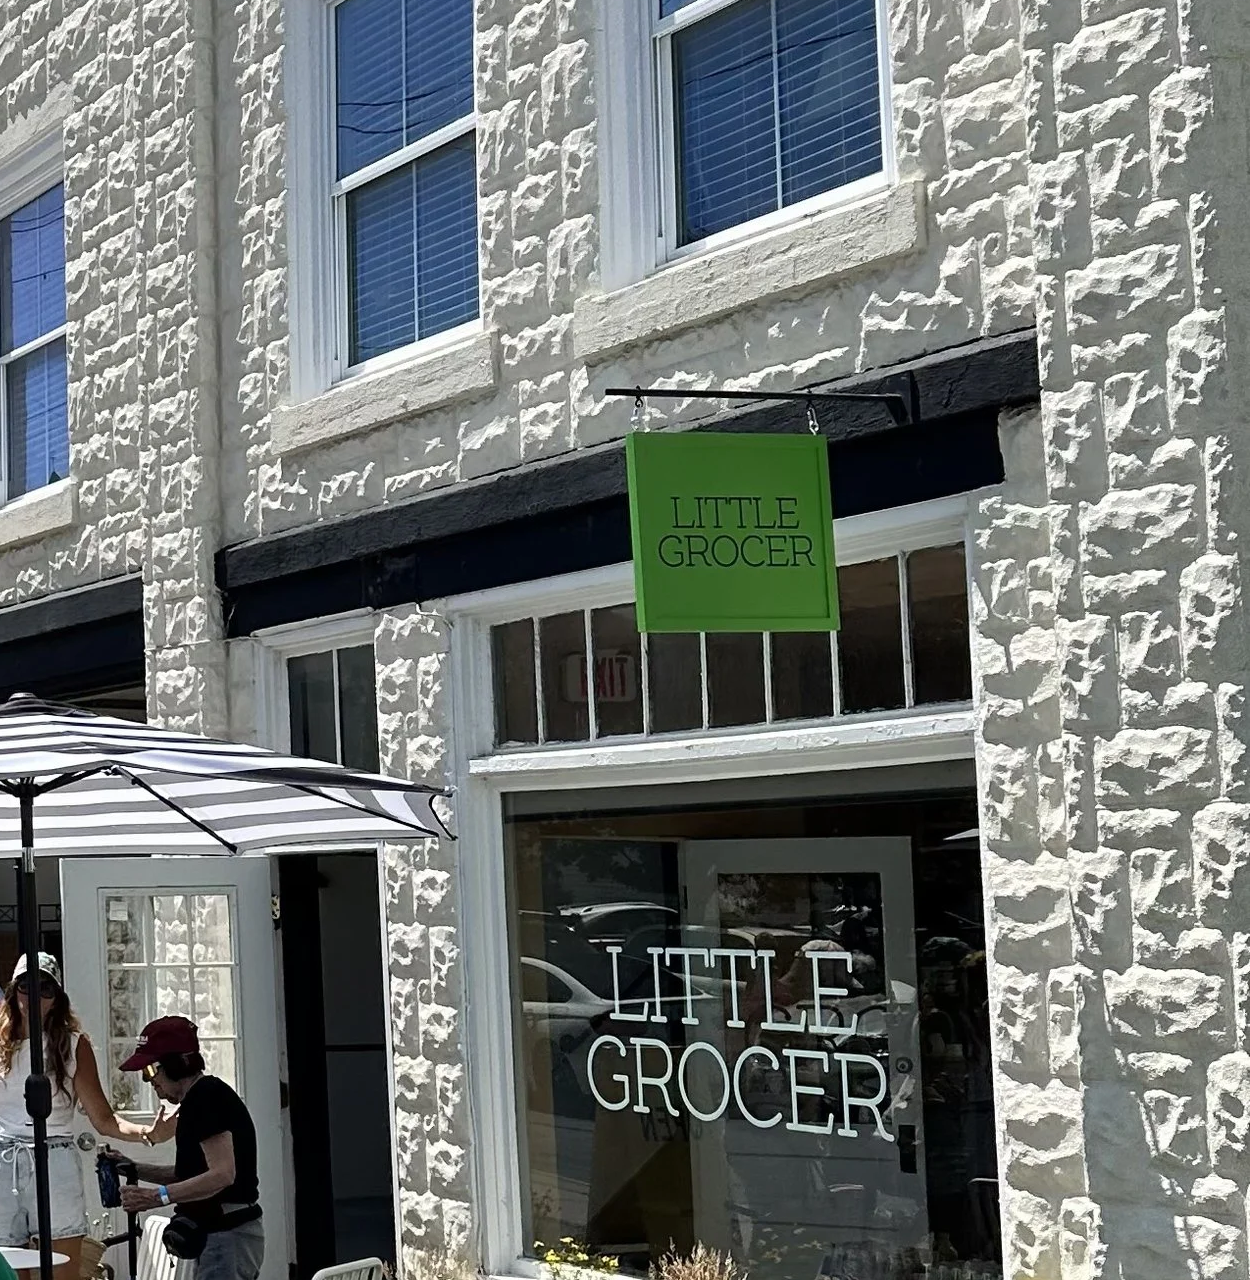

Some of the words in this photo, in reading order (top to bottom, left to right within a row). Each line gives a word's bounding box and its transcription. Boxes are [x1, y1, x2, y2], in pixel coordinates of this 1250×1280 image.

[669, 495, 800, 530] LITTLE
[657, 534, 816, 568] GROCER
[605, 945, 859, 1035] LITTLE
[586, 1034, 895, 1142] GROCER
